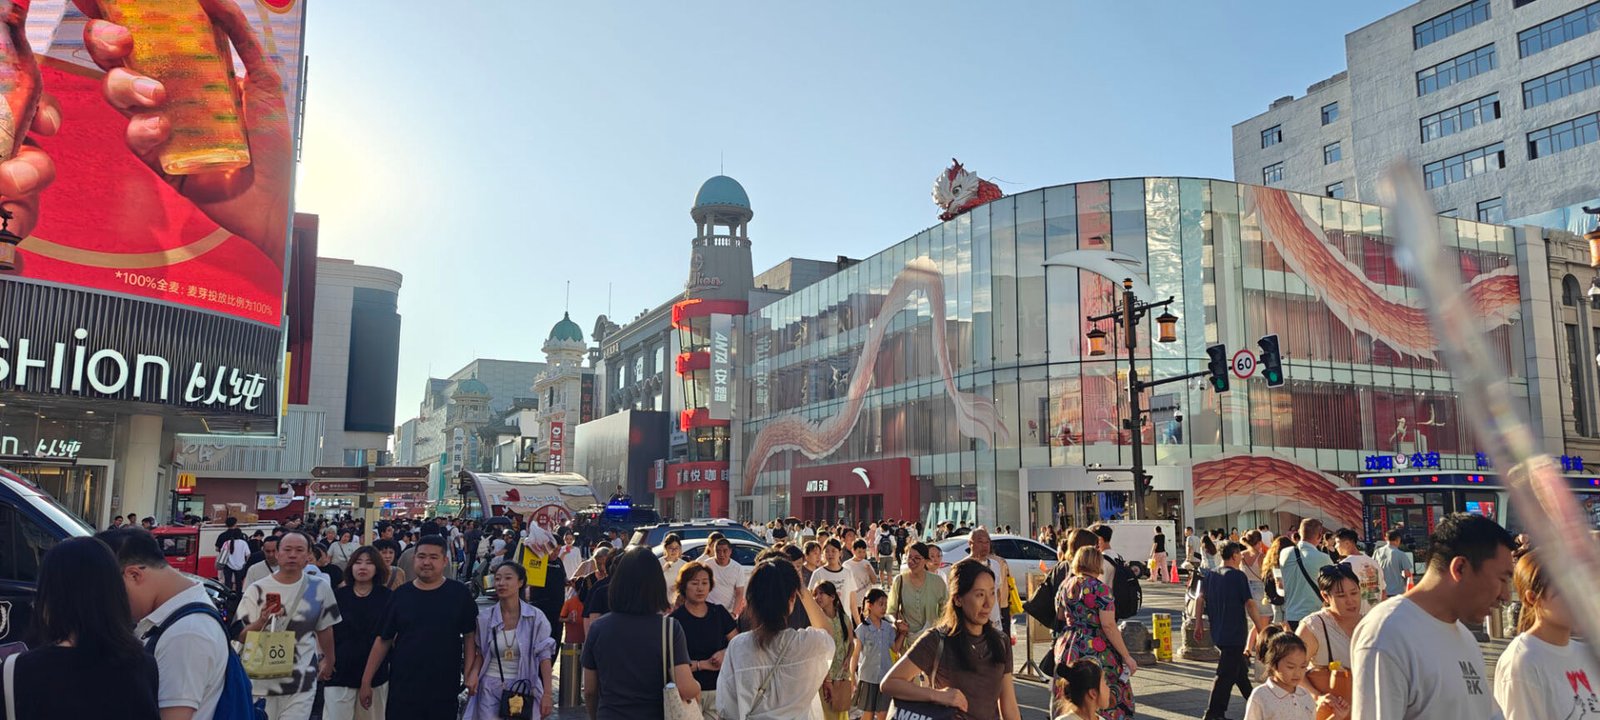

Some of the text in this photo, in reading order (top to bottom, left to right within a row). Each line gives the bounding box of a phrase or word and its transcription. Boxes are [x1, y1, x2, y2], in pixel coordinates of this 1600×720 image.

[714, 331, 728, 402] ANTA 安踏
[1237, 357, 1252, 370] 60
[185, 362, 267, 410] 以纯
[36, 438, 82, 457] 以纯
[1365, 455, 1393, 470] 沈阳
[1410, 451, 1440, 467] 公安
[1458, 660, 1477, 676] MA
[1466, 679, 1483, 695] RK
